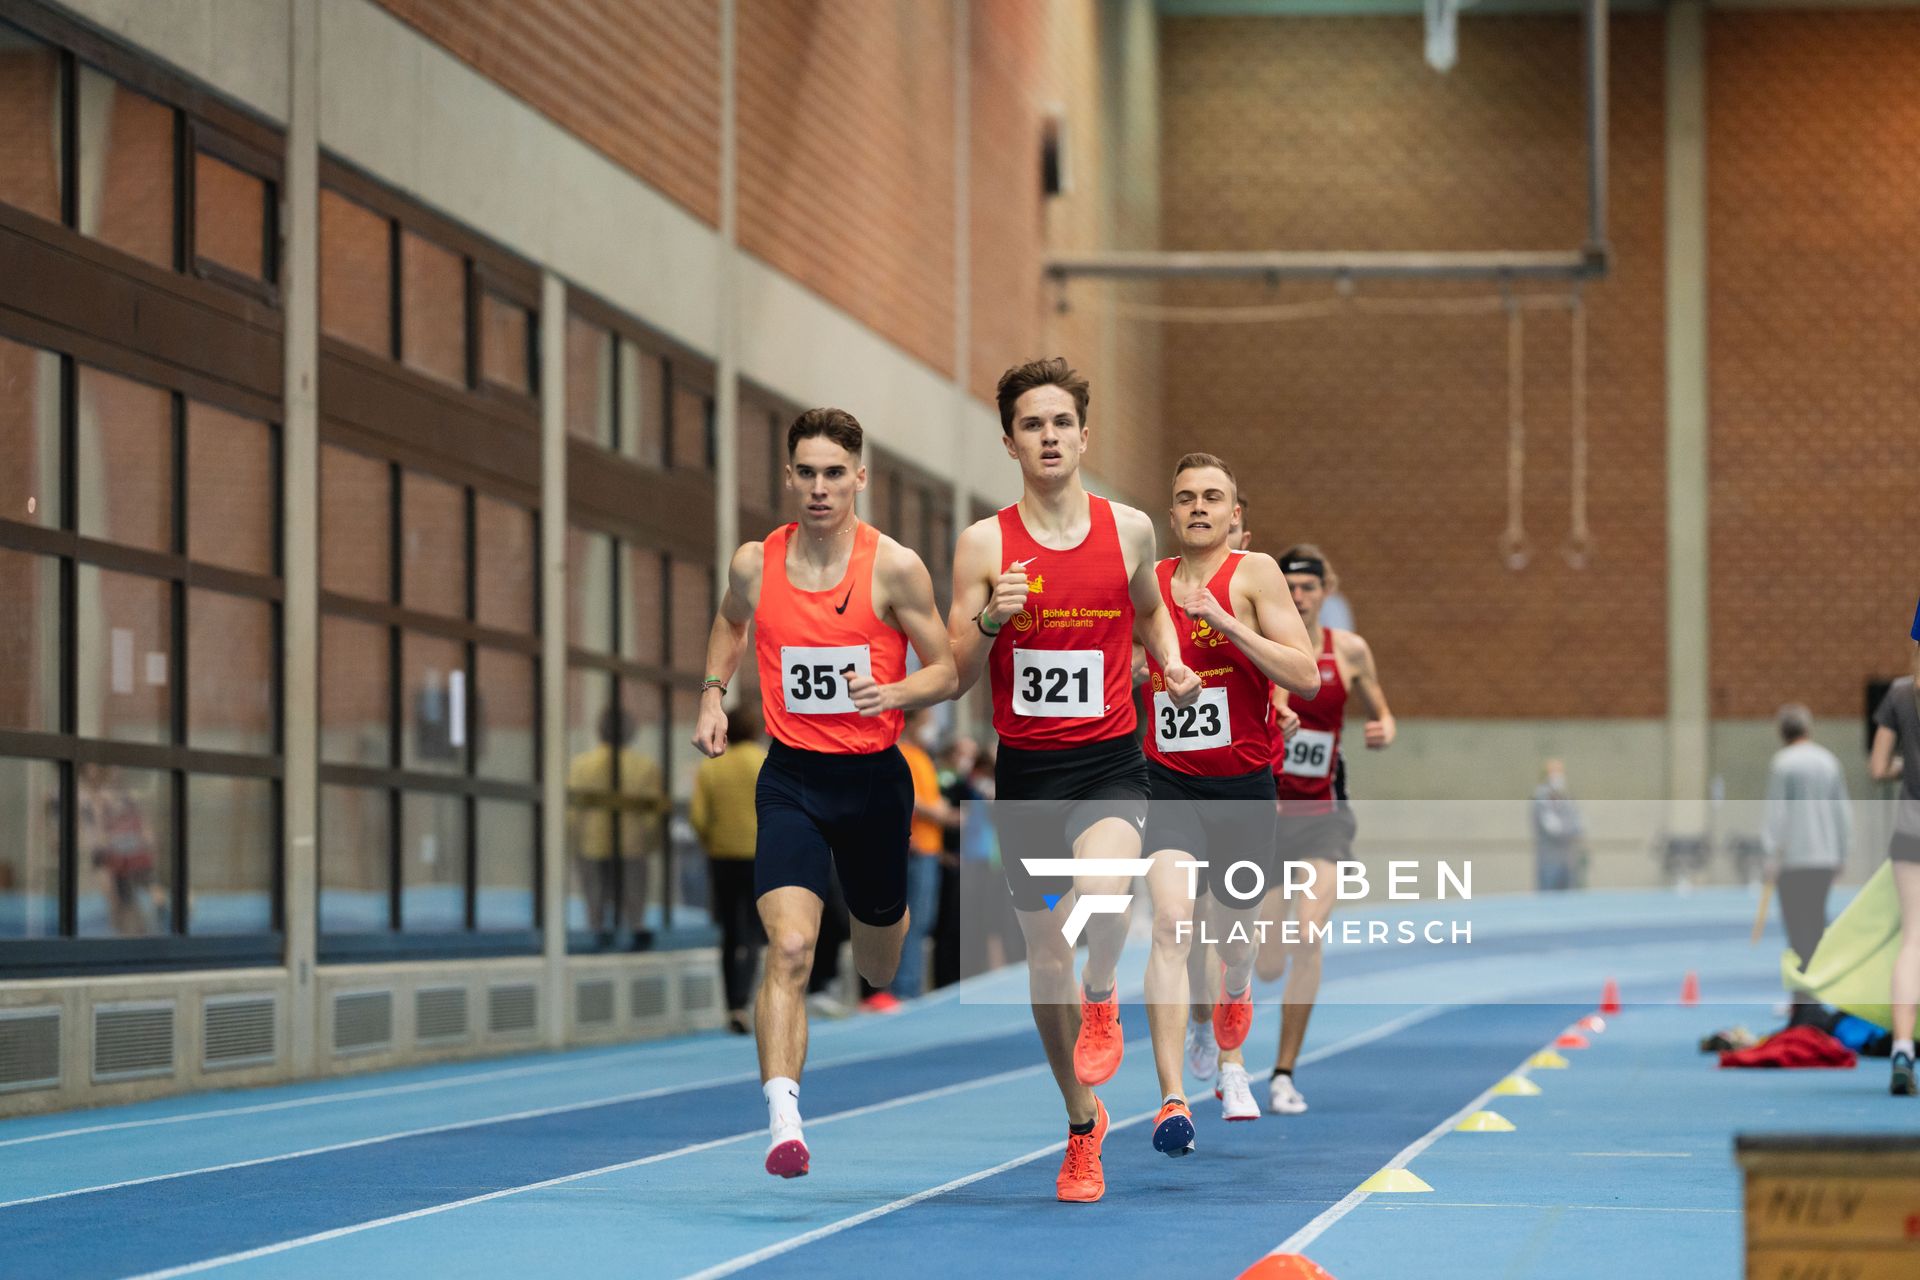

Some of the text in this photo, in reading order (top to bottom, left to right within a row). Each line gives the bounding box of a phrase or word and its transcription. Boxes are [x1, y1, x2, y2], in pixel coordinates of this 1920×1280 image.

[1043, 608, 1122, 619] Böhke & Compagnie
[1043, 619, 1094, 628] Consultants
[1021, 667, 1089, 703] 321
[1161, 703, 1221, 739] 323
[1284, 741, 1326, 767] 96
